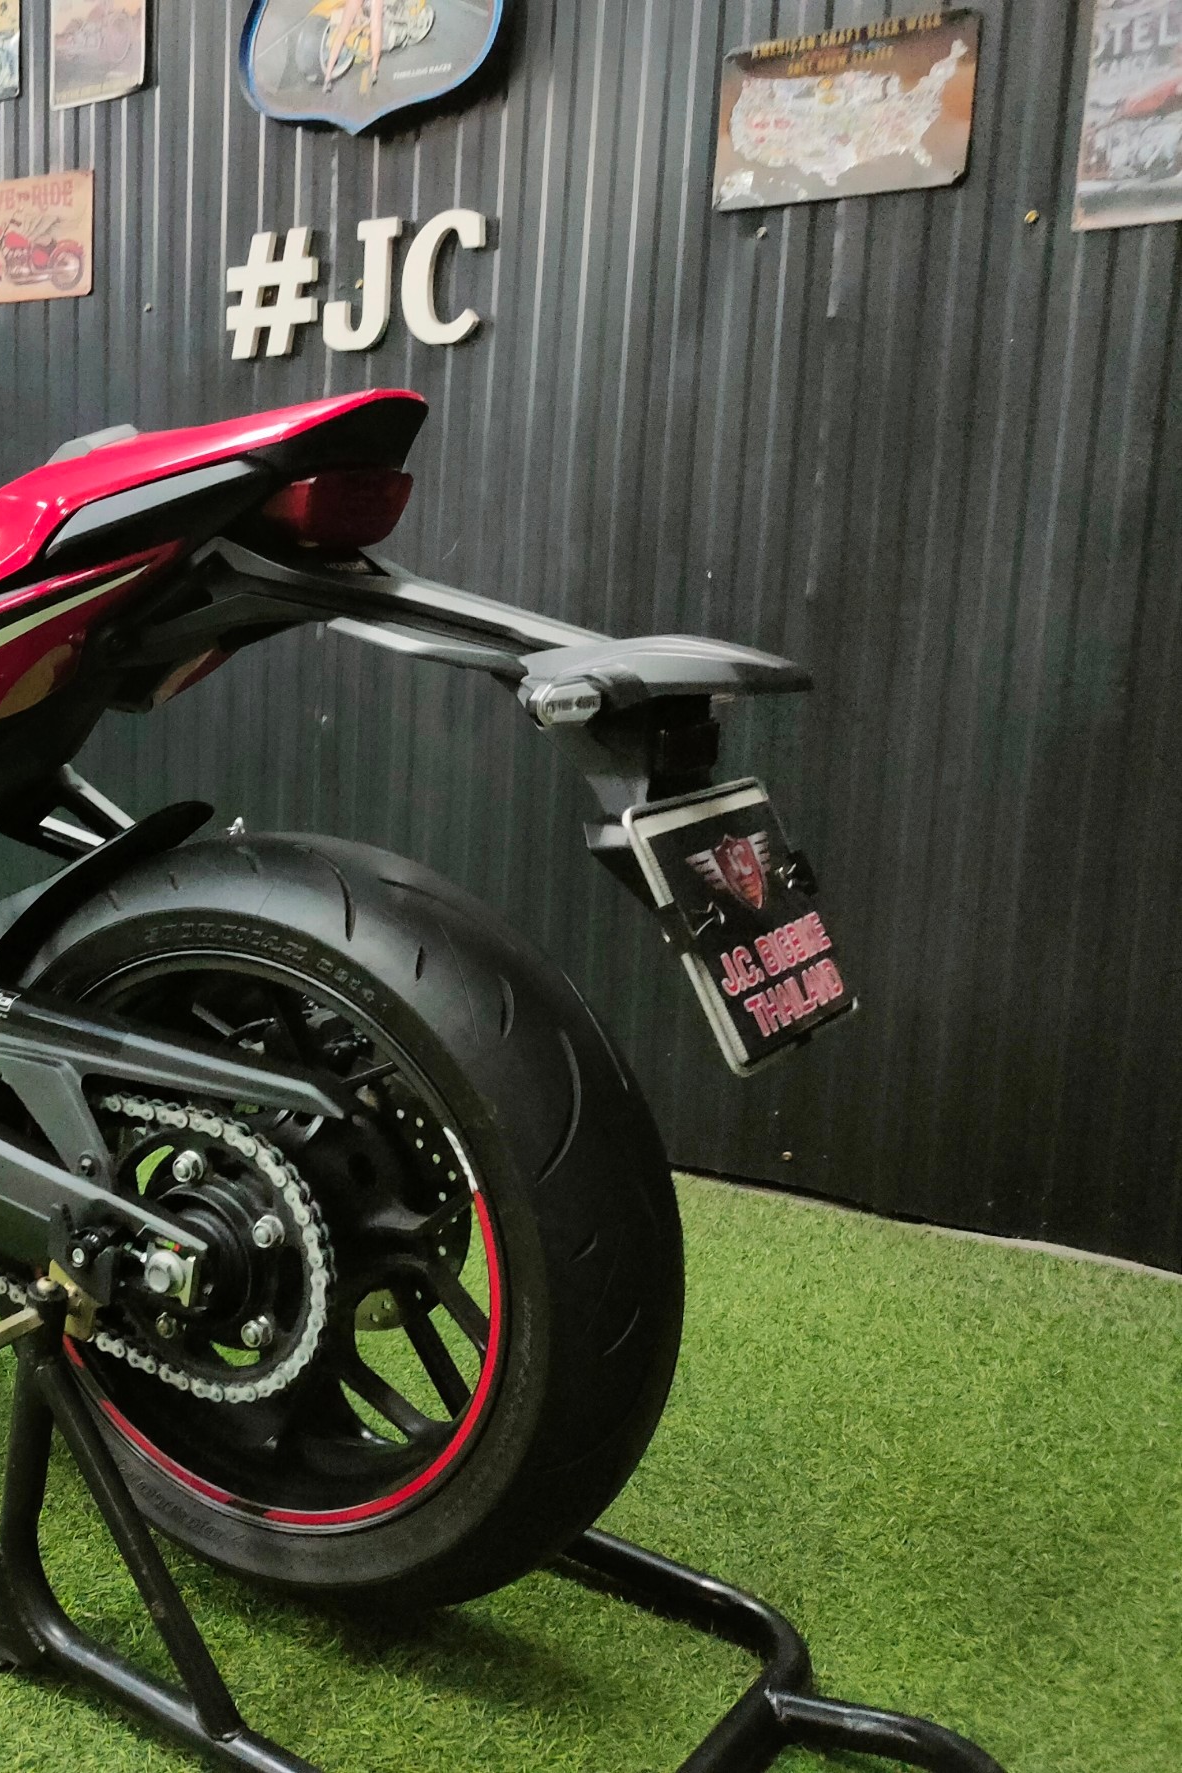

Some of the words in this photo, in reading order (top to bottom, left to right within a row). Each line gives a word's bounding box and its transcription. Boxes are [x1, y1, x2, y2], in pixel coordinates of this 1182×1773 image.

[31, 179, 75, 212] RIDE
[226, 208, 487, 360] #JC
[743, 957, 844, 1037] THAILAND
